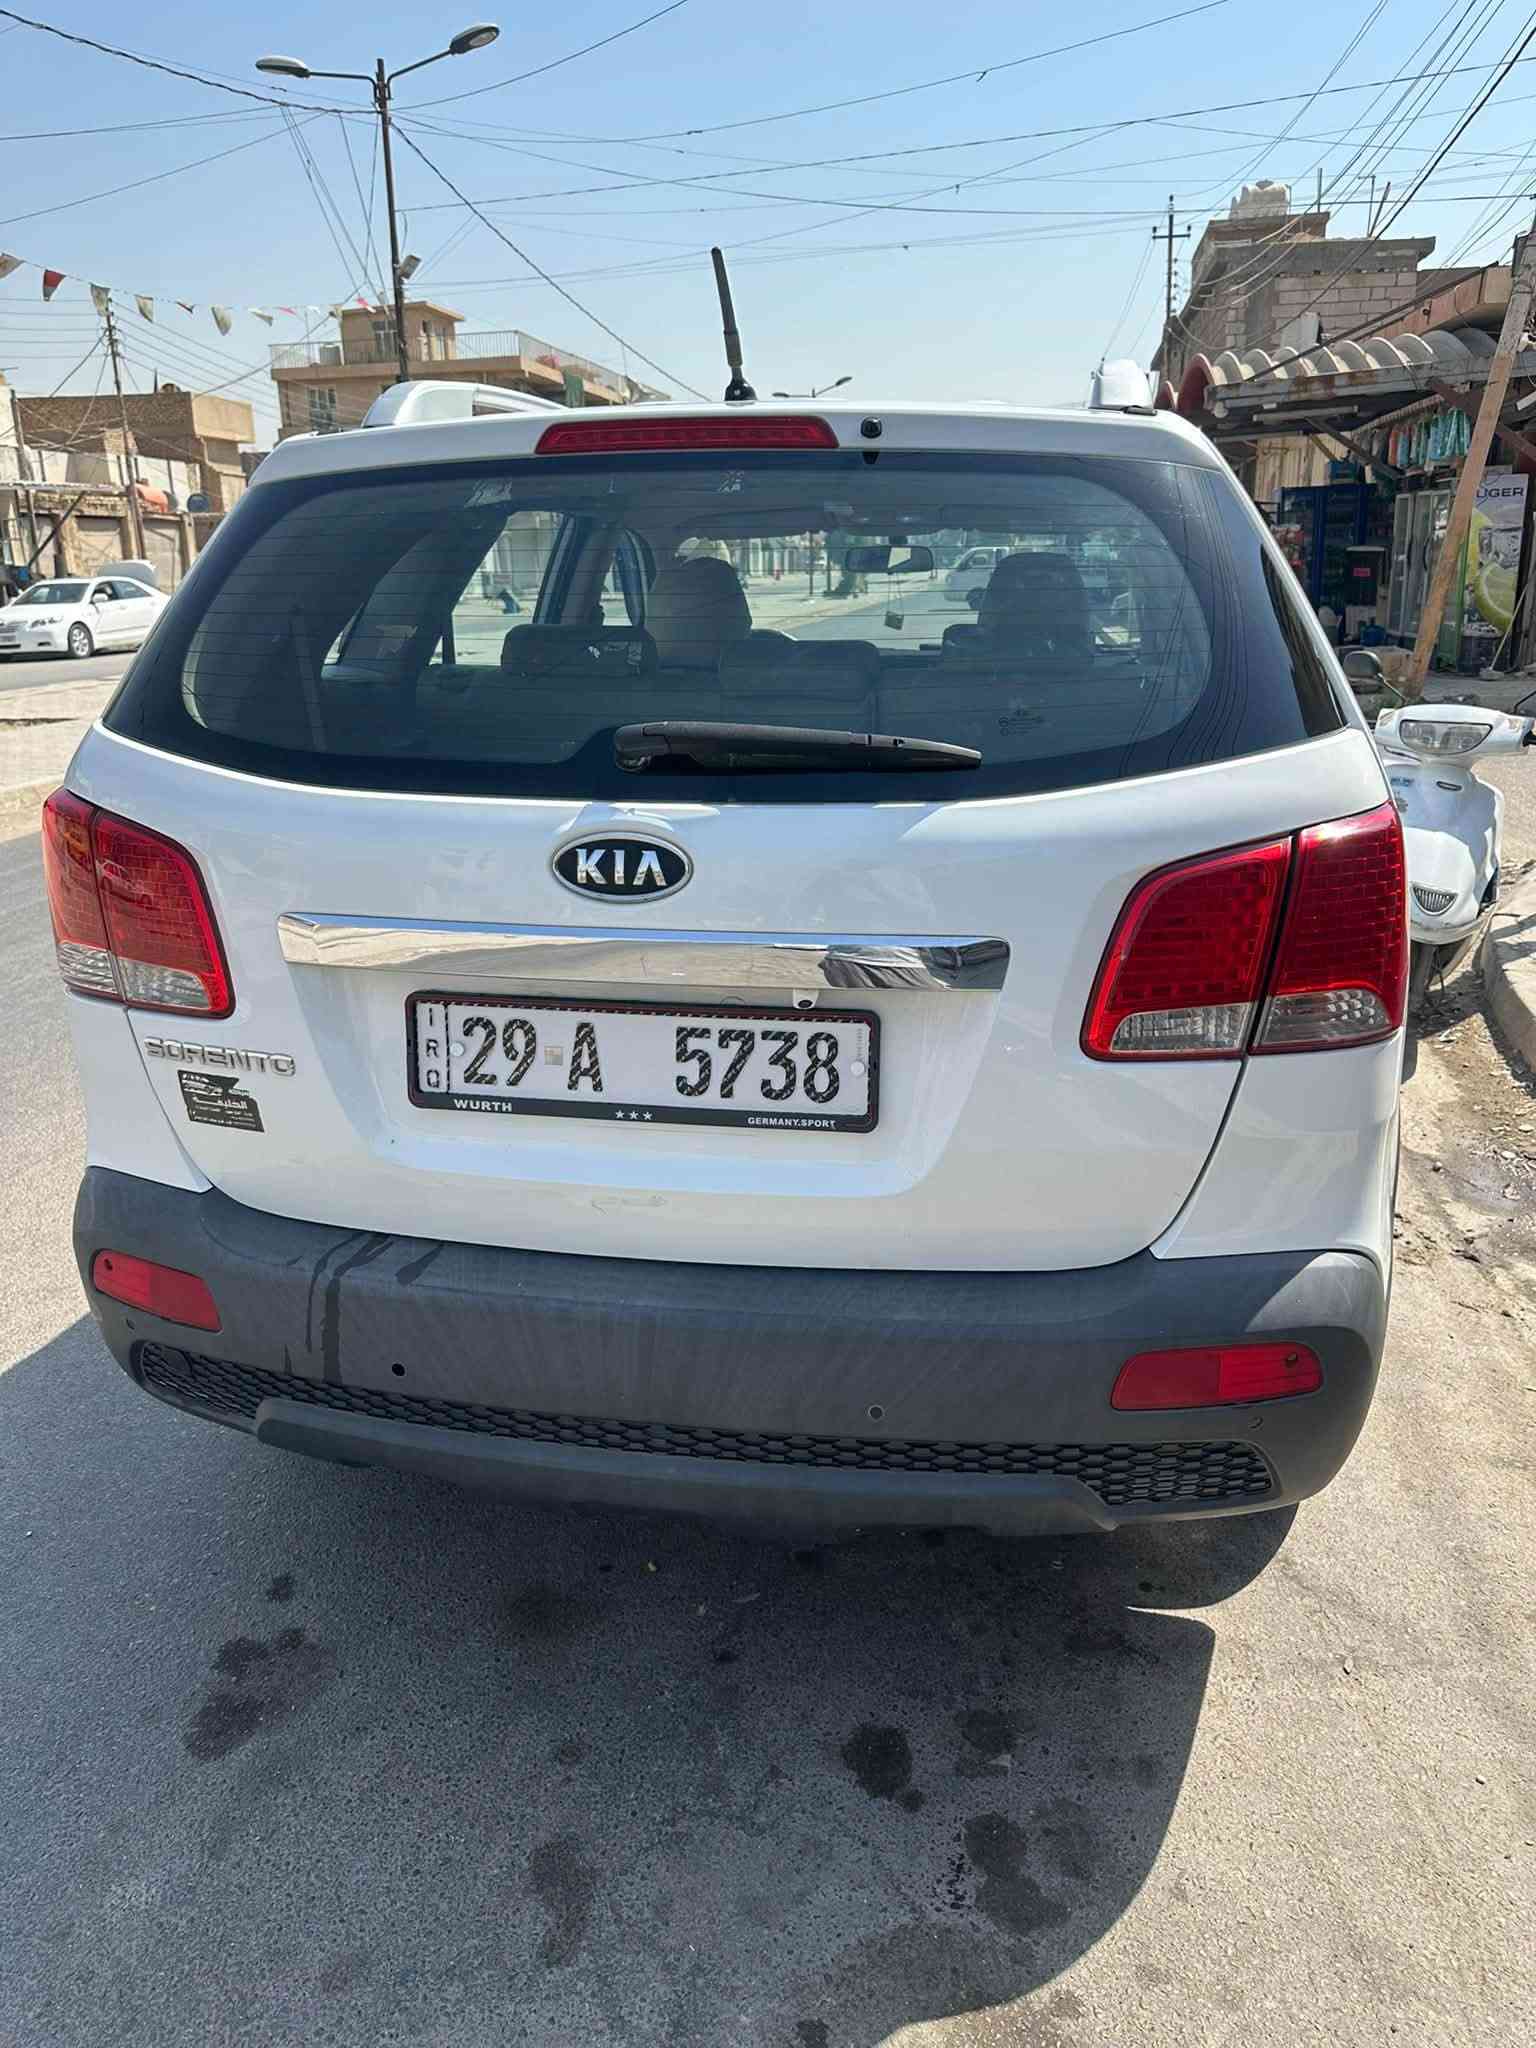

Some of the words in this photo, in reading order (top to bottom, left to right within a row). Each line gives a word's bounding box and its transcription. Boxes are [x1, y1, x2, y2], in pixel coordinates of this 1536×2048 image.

[1476, 487, 1524, 498] UGER
[575, 847, 667, 886] KIA
[143, 1036, 296, 1077] SORENTO
[463, 1016, 537, 1087] 29
[567, 1021, 603, 1093] A
[676, 1026, 840, 1104] 5738
[453, 1098, 513, 1112] WURTH
